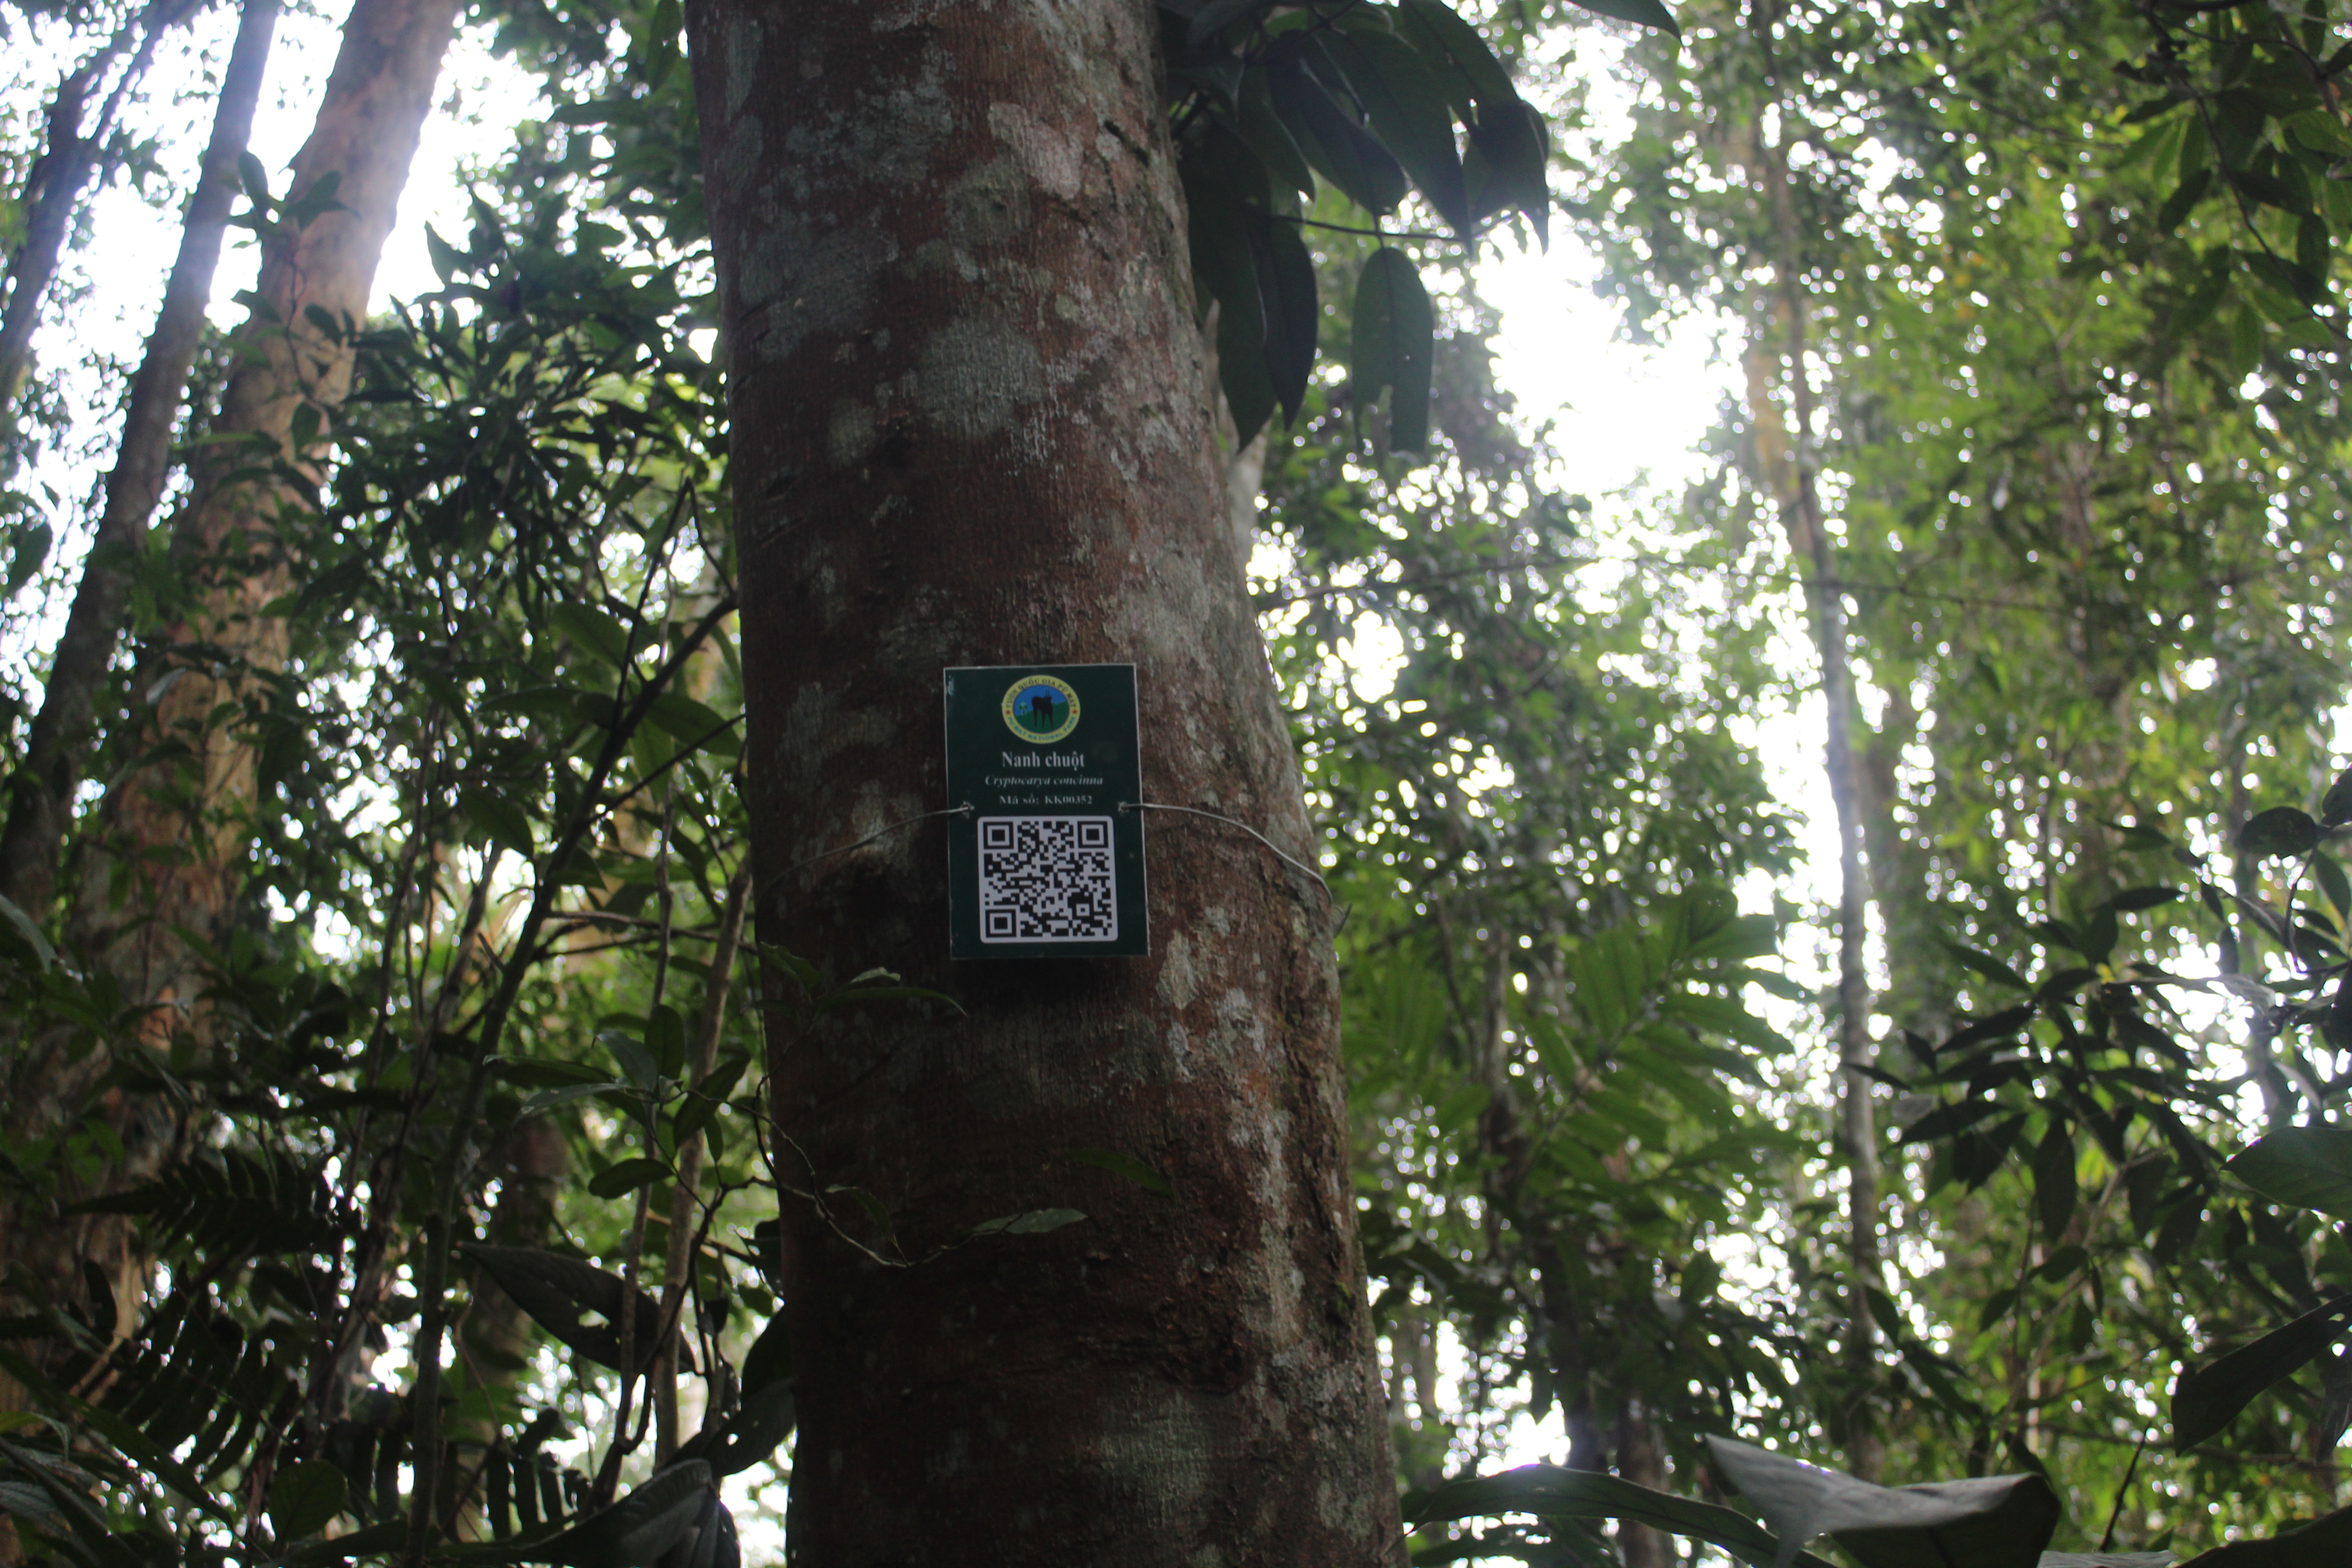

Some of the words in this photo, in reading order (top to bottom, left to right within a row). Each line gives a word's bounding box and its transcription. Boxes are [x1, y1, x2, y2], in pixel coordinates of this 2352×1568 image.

[1002, 751, 1040, 767] Nanh
[1045, 750, 1084, 771] chuột
[985, 775, 1050, 788] Cryptocarya
[1053, 774, 1103, 785] concinna
[1000, 795, 1019, 804] Mã
[1045, 795, 1092, 804] KK00352
